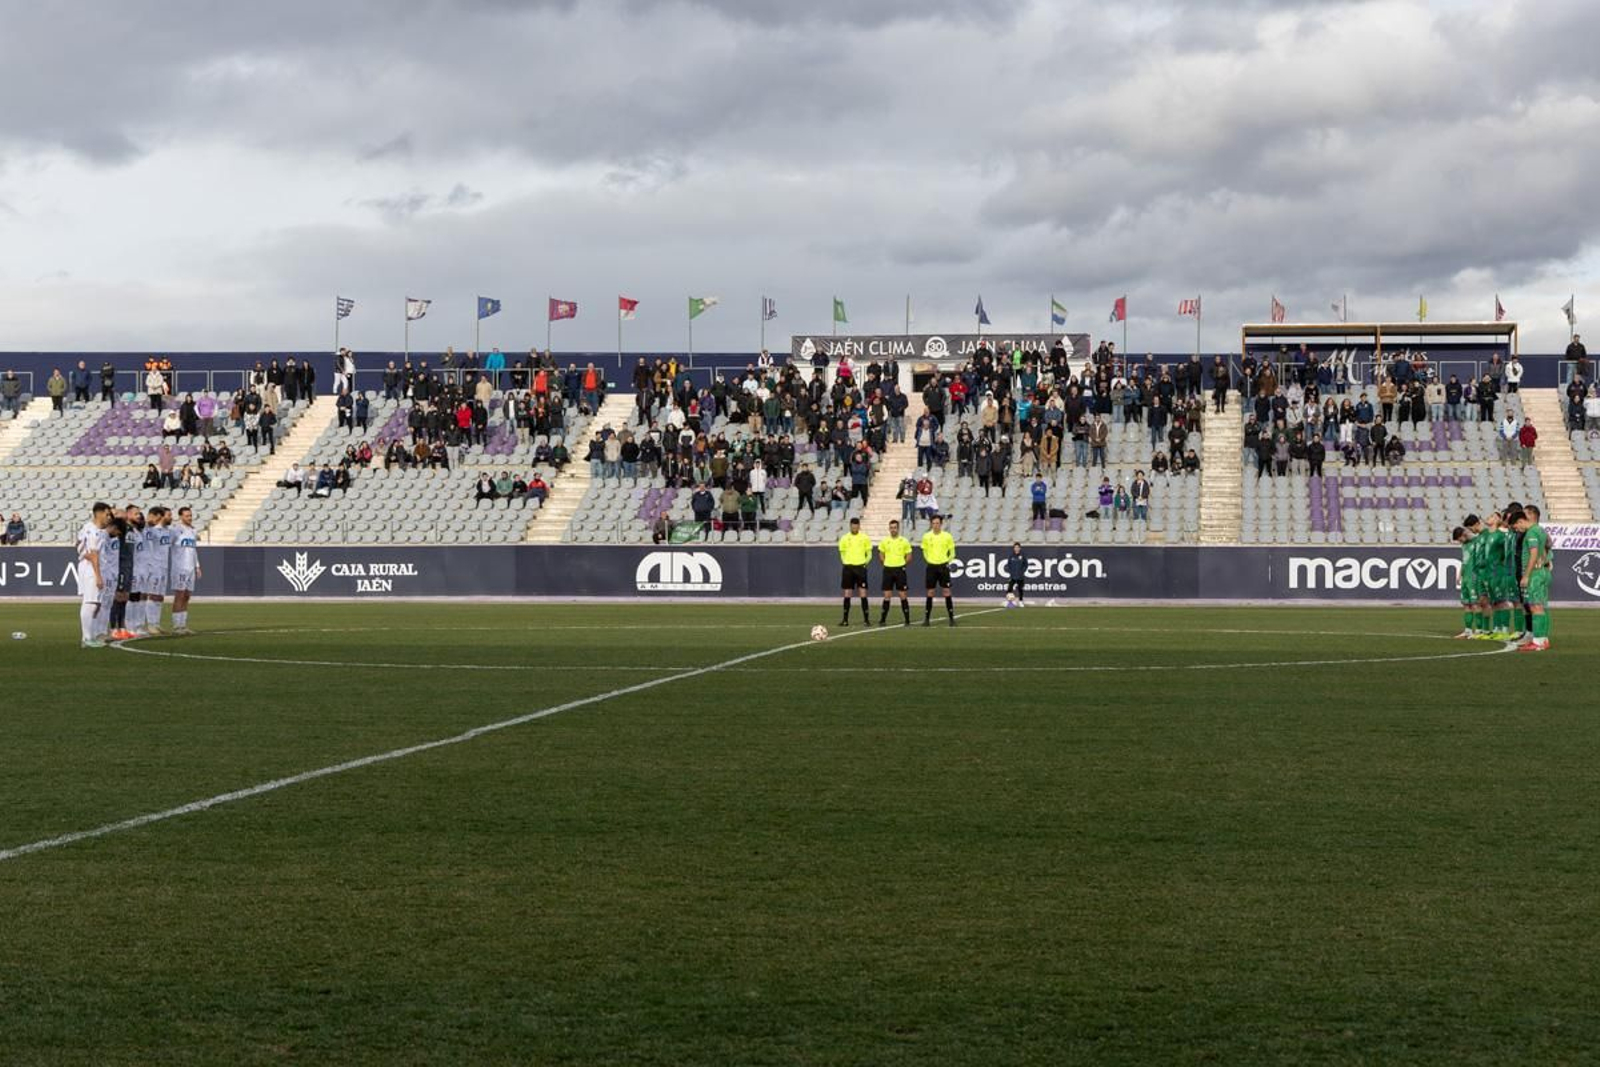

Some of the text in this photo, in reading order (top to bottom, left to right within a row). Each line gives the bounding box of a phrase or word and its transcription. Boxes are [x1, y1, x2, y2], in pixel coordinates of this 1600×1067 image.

[868, 340, 915, 355] CLIMA
[929, 342, 943, 352] 30
[331, 563, 418, 576] CAJA RURAL
[1288, 557, 1462, 590] macron
[356, 577, 392, 592] JAÉN
[1012, 582, 1068, 591] aestras
